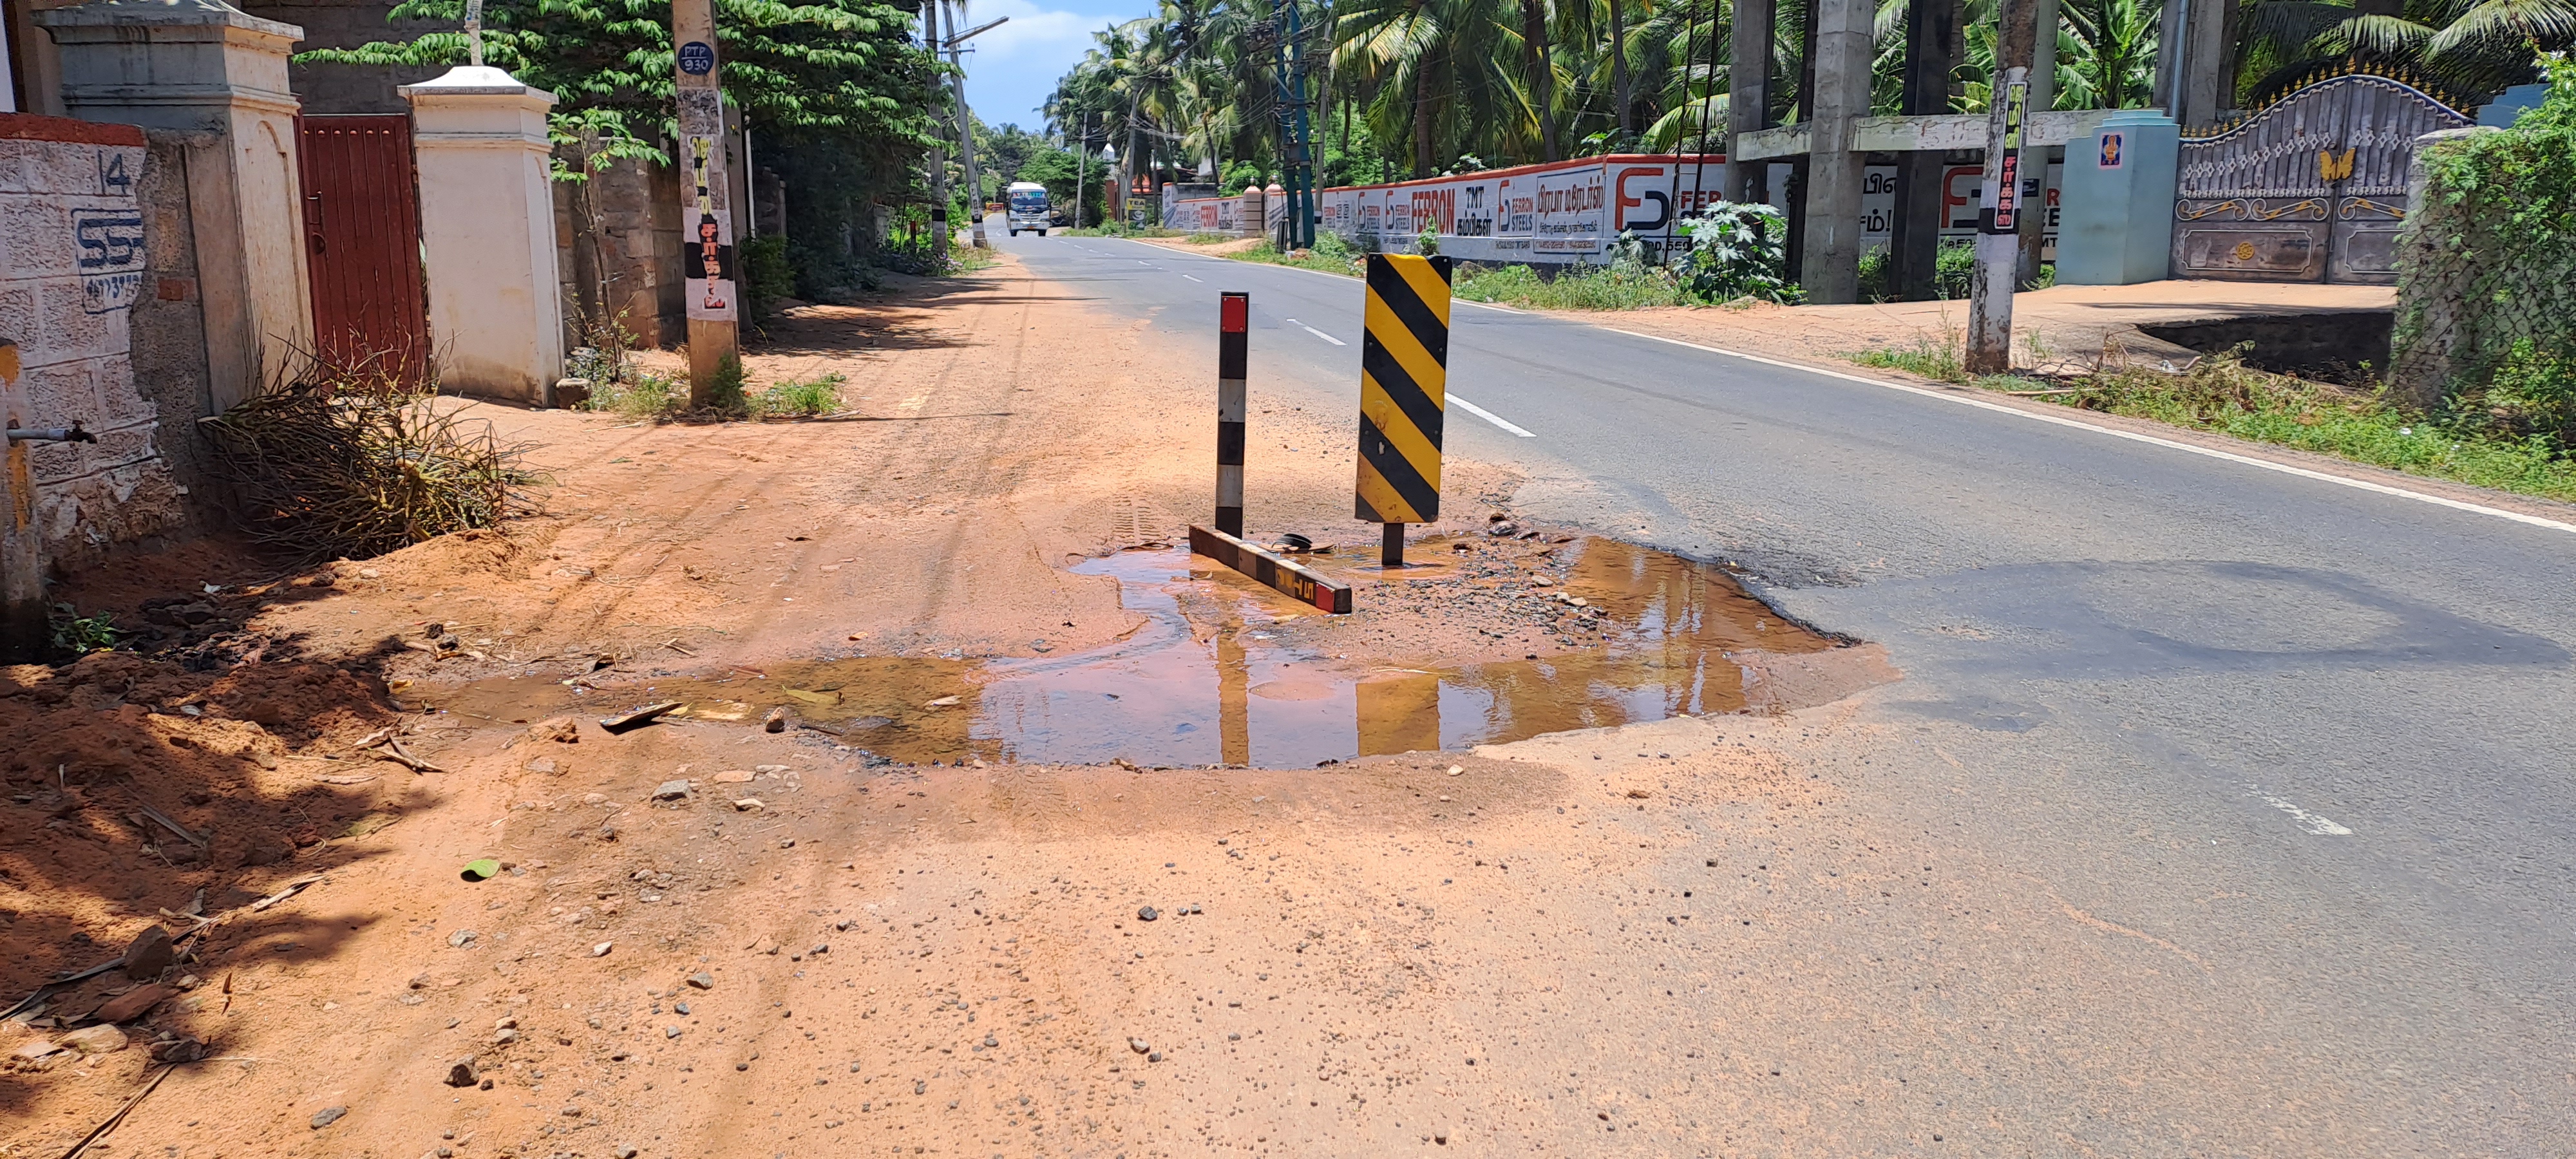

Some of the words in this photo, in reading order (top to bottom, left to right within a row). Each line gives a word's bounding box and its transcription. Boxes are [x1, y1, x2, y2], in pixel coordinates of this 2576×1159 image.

[685, 46, 706, 57] PTP
[684, 59, 708, 71] 930
[1466, 186, 1484, 209] TMT
[1511, 197, 1533, 214] FERRON
[1412, 188, 1455, 234] FERRON
[1457, 209, 1492, 236] கம்பிகள்
[1511, 214, 1533, 232] STEELS
